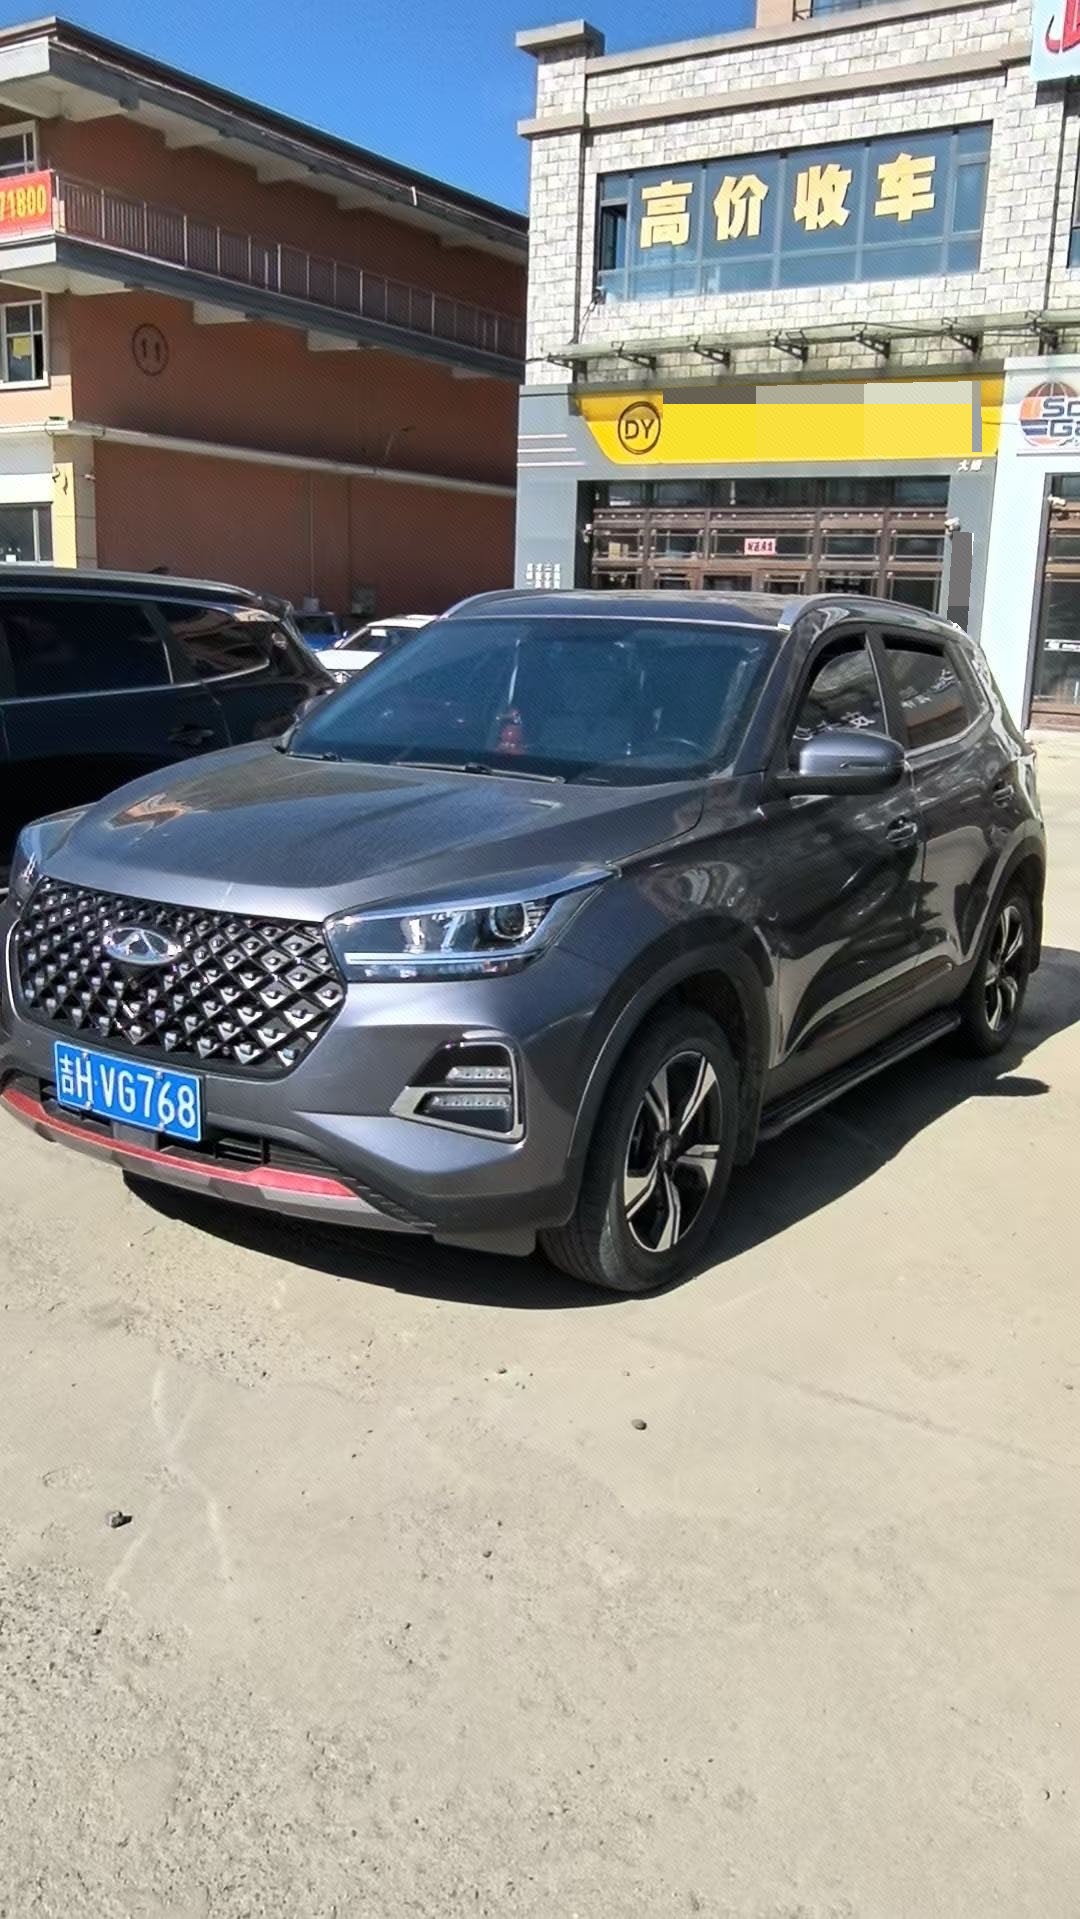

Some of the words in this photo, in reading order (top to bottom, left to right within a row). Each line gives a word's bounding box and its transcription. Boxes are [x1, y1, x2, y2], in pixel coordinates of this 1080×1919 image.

[640, 152, 936, 249] 高价收车
[625, 418, 655, 439] DY
